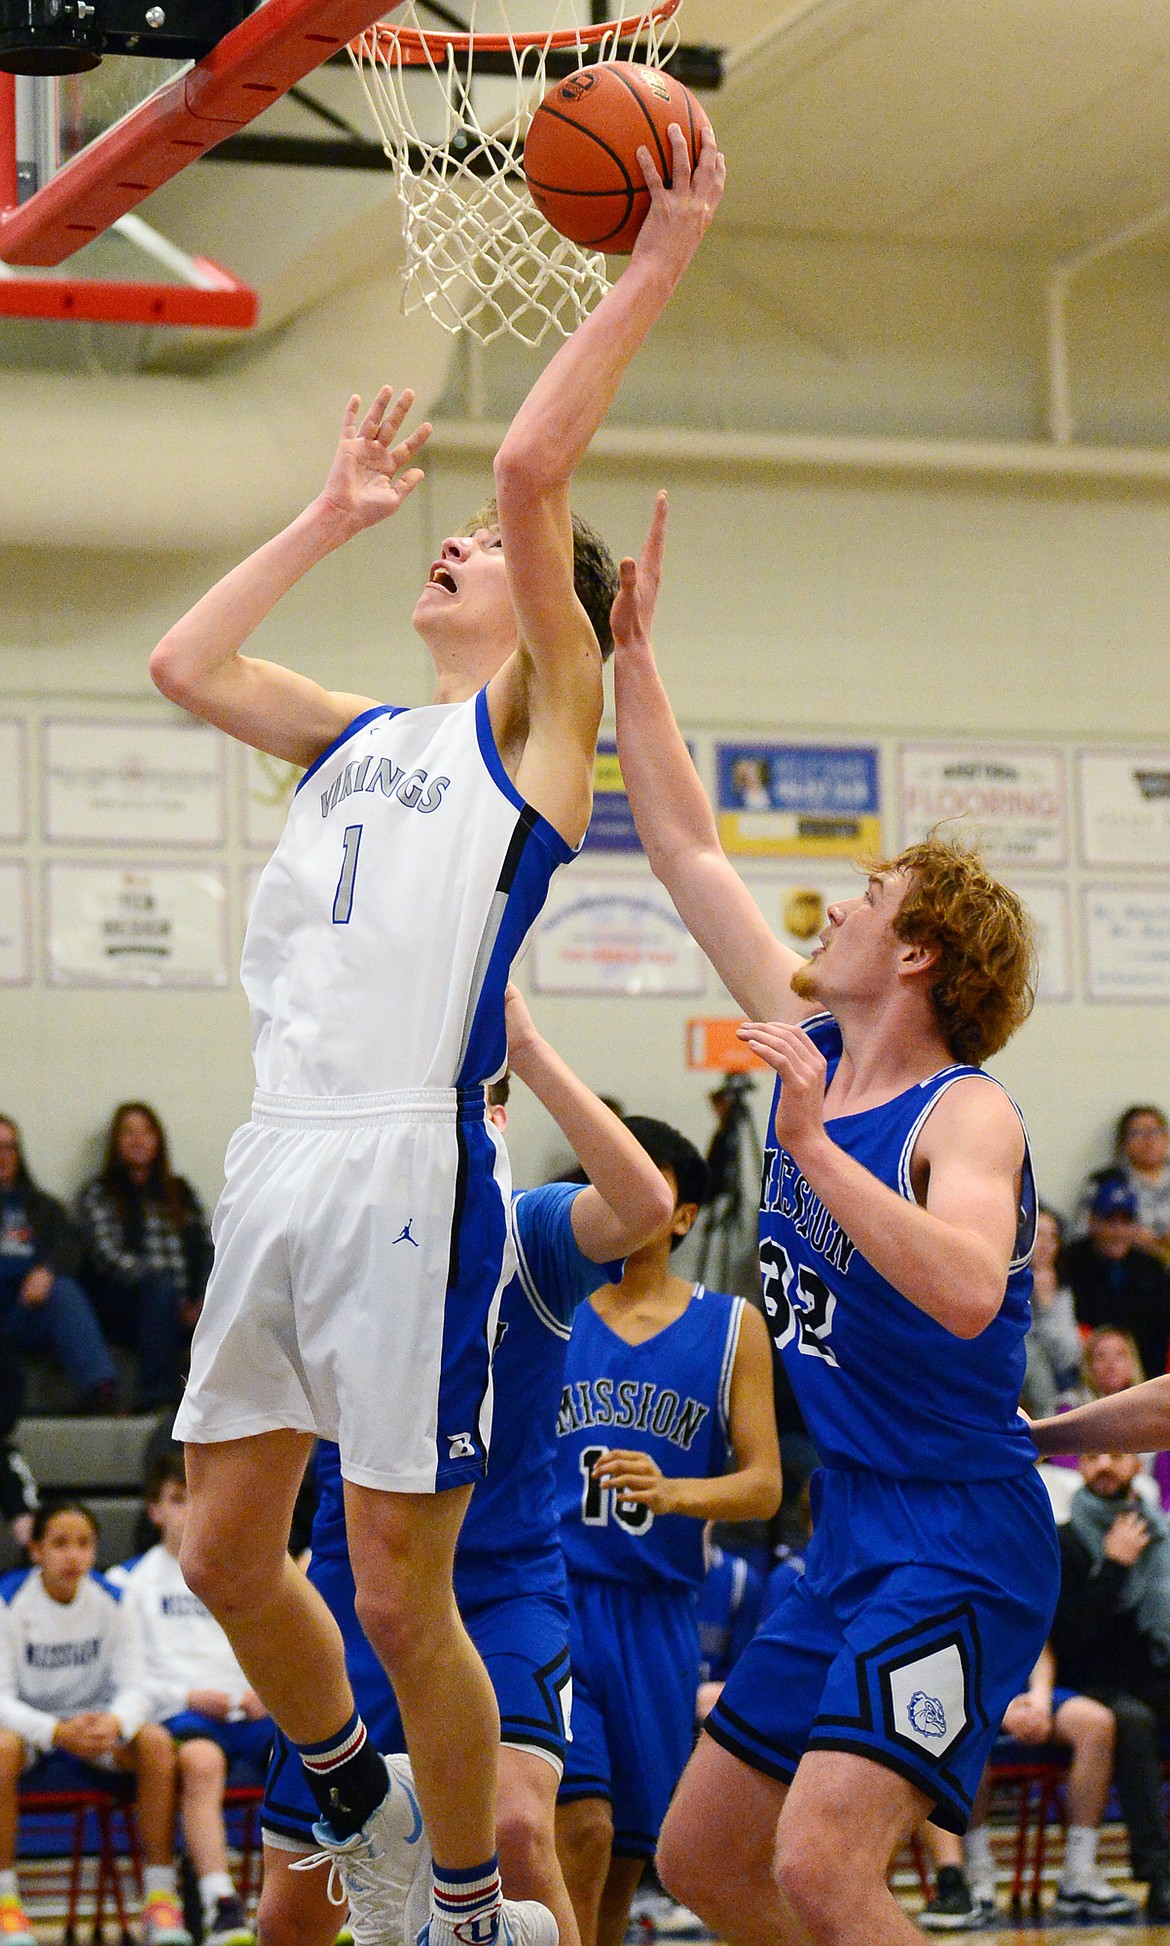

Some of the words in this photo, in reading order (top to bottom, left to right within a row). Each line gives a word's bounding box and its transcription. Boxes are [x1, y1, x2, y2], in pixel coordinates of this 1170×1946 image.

[320, 755, 451, 818] VIKINGS
[332, 824, 364, 924] 1
[759, 1236, 841, 1368] 32
[555, 1377, 710, 1451] MISSION
